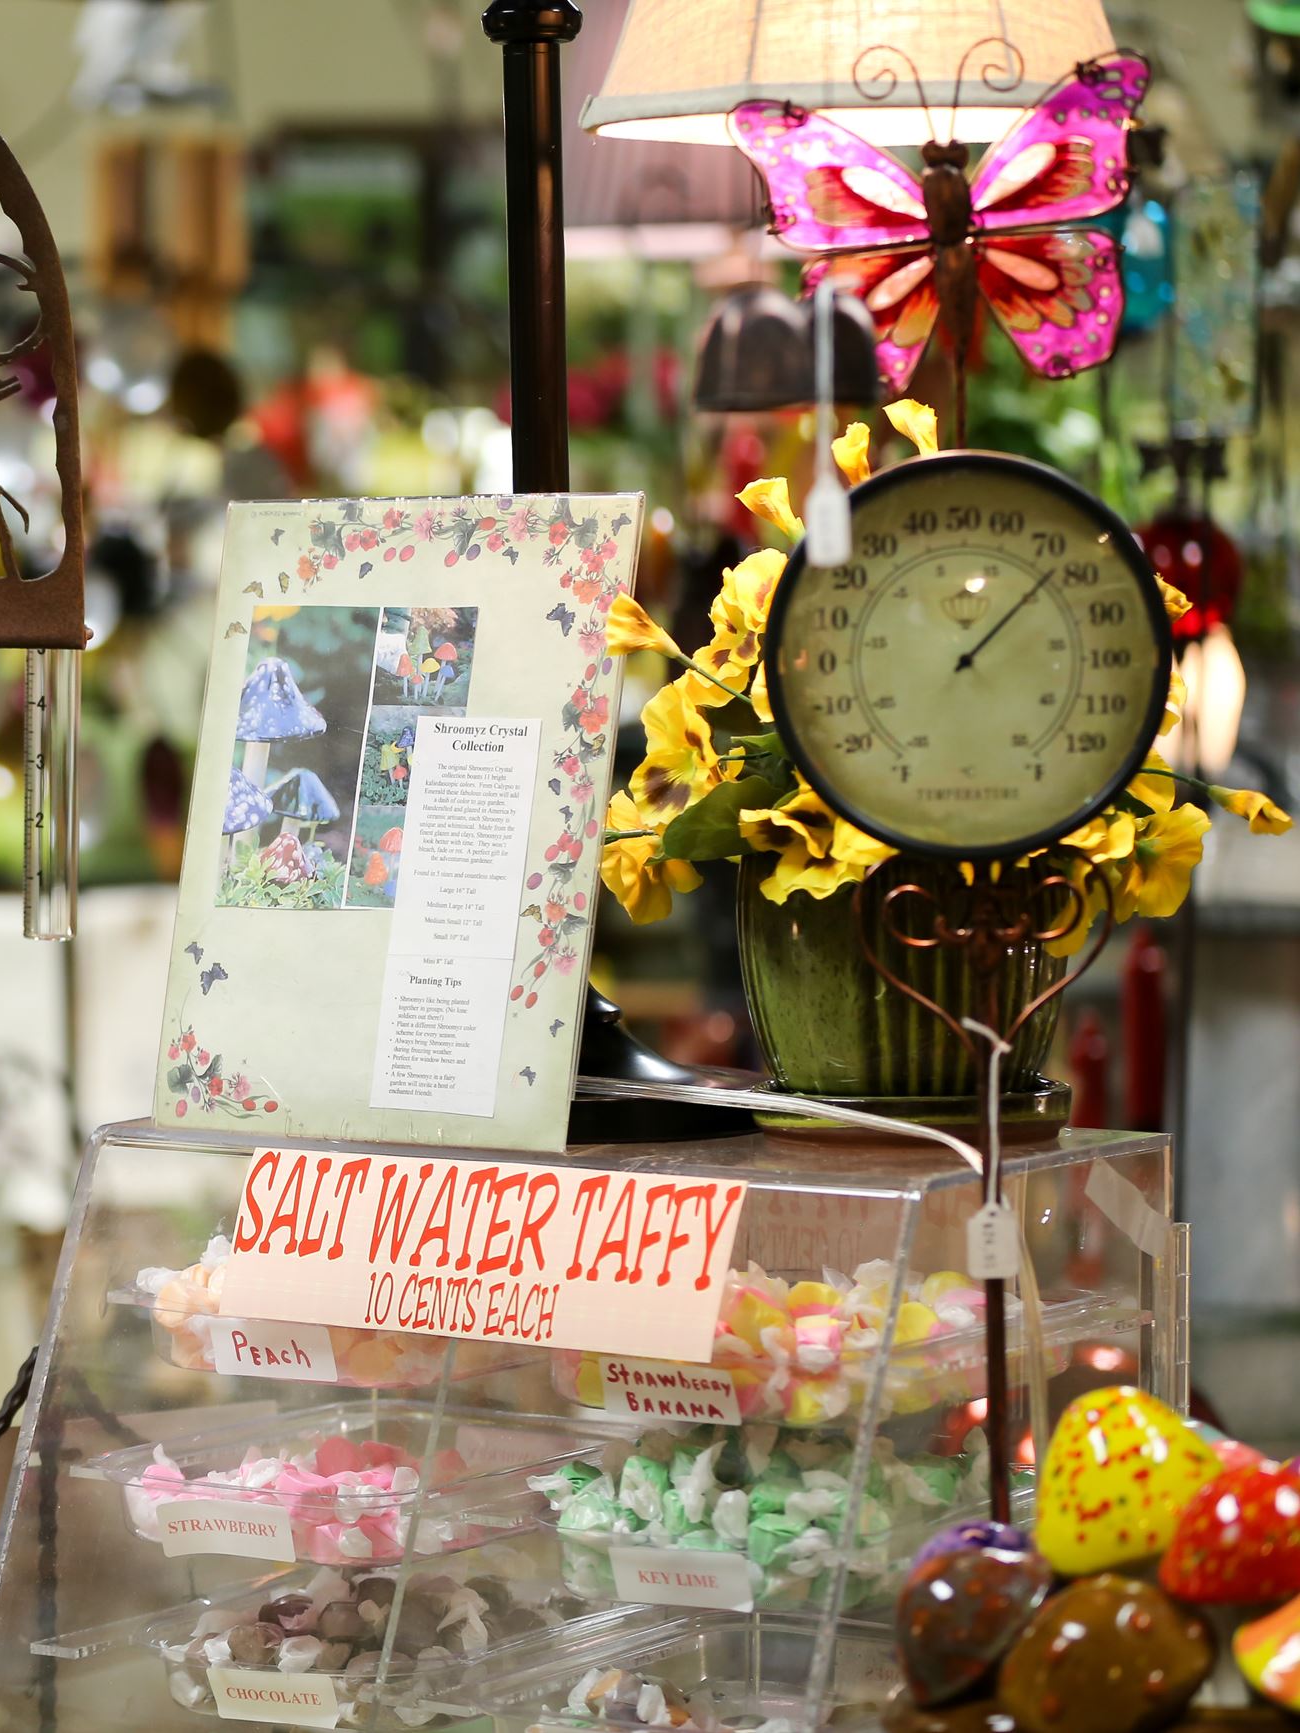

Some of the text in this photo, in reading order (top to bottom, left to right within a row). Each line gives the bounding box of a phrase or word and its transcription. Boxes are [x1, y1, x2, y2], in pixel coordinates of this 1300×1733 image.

[904, 512, 939, 535] 40
[945, 507, 980, 532] 50
[989, 511, 1024, 534] 60
[862, 535, 898, 558] 30
[1032, 534, 1066, 557] 70
[832, 568, 867, 590] 20
[1062, 563, 1099, 585] 80
[815, 608, 849, 630] 10
[1089, 604, 1125, 626] 90
[818, 651, 837, 675] 0
[1090, 648, 1131, 668] 100
[36, 696, 48, 712] 4
[814, 696, 851, 716] -10
[1085, 695, 1126, 714] 110
[434, 723, 528, 738] Shroomyz Crystal
[452, 740, 504, 752] Collection
[835, 734, 872, 752] -20
[1066, 734, 1106, 754] 120
[36, 754, 45, 770] 3
[35, 812, 44, 829] 2
[36, 871, 44, 888] 1
[410, 976, 462, 988] Planting Tips
[411, 1047, 431, 1055] freezing
[234, 1150, 371, 1260] SALT
[368, 1162, 560, 1276] WATER
[566, 1174, 742, 1292] TAFFY
[364, 1272, 560, 1342] 10 CENTS EACH
[626, 1392, 724, 1418] BANANA
[167, 1516, 278, 1540] STRAWBERRY
[638, 1568, 719, 1590] KEY LIME
[226, 1686, 322, 1708] CHOCOLATE
